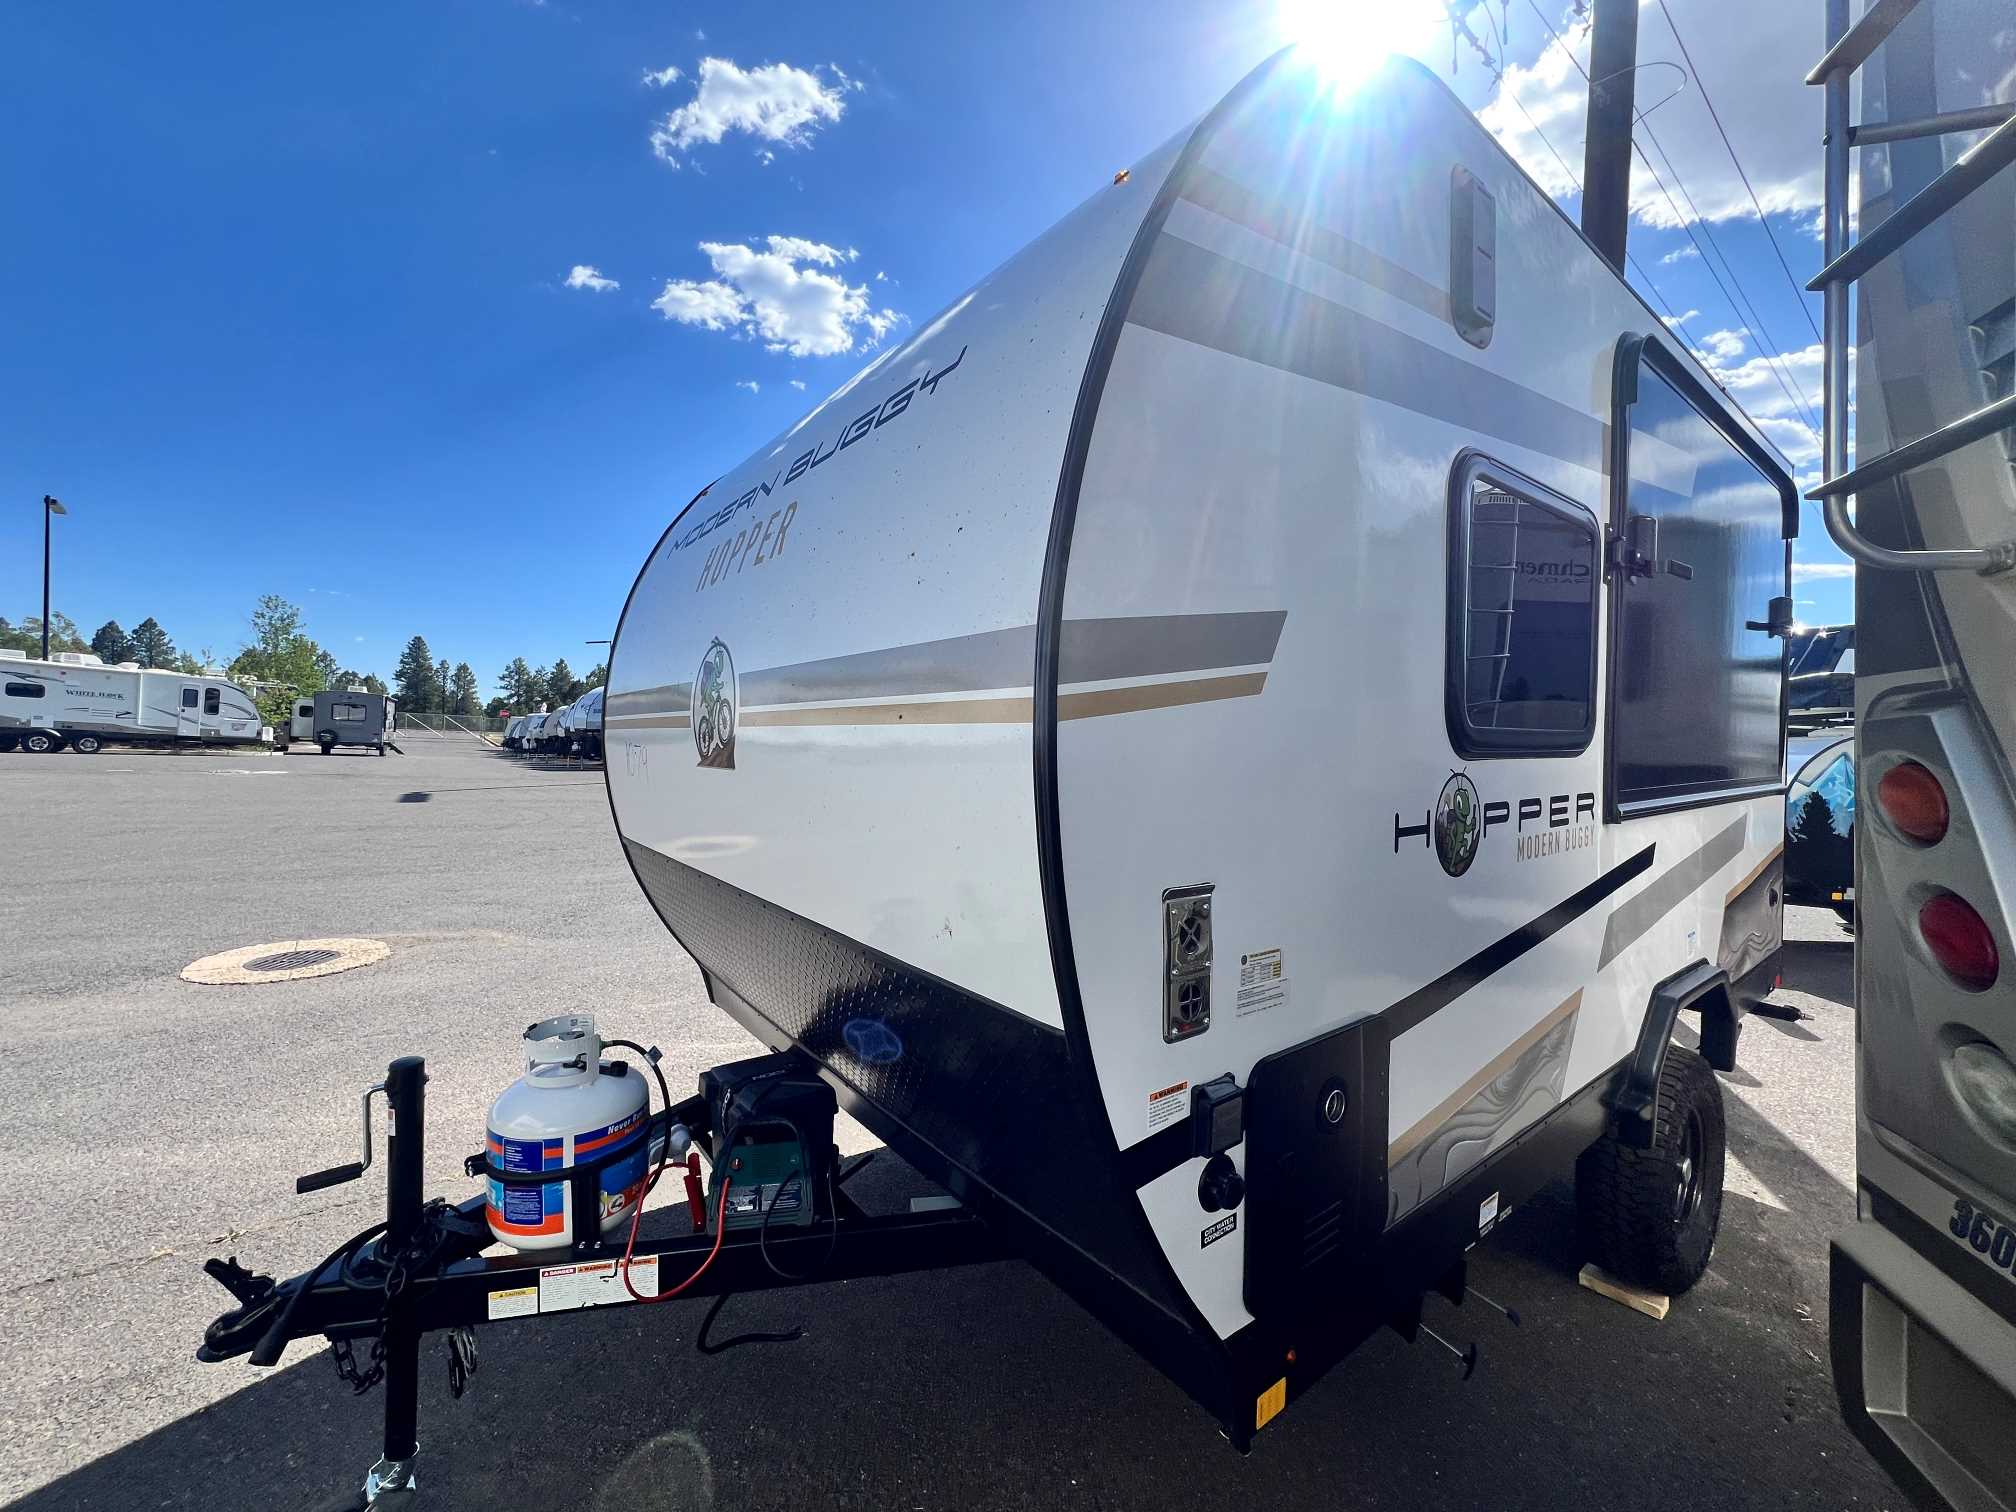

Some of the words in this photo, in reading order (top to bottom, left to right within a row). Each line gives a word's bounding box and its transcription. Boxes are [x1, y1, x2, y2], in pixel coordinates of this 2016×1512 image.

[668, 470, 781, 560] MODERN
[783, 345, 968, 486] BUGGY
[696, 501, 798, 592] HOPPER
[1394, 775, 1595, 873] HOPPER
[1517, 832, 1561, 862] MODERN
[1565, 824, 1595, 851] BUGGY
[1216, 1216, 1234, 1229] WATER
[1949, 1199, 2016, 1278] 360
[549, 1268, 574, 1277] DANGER
